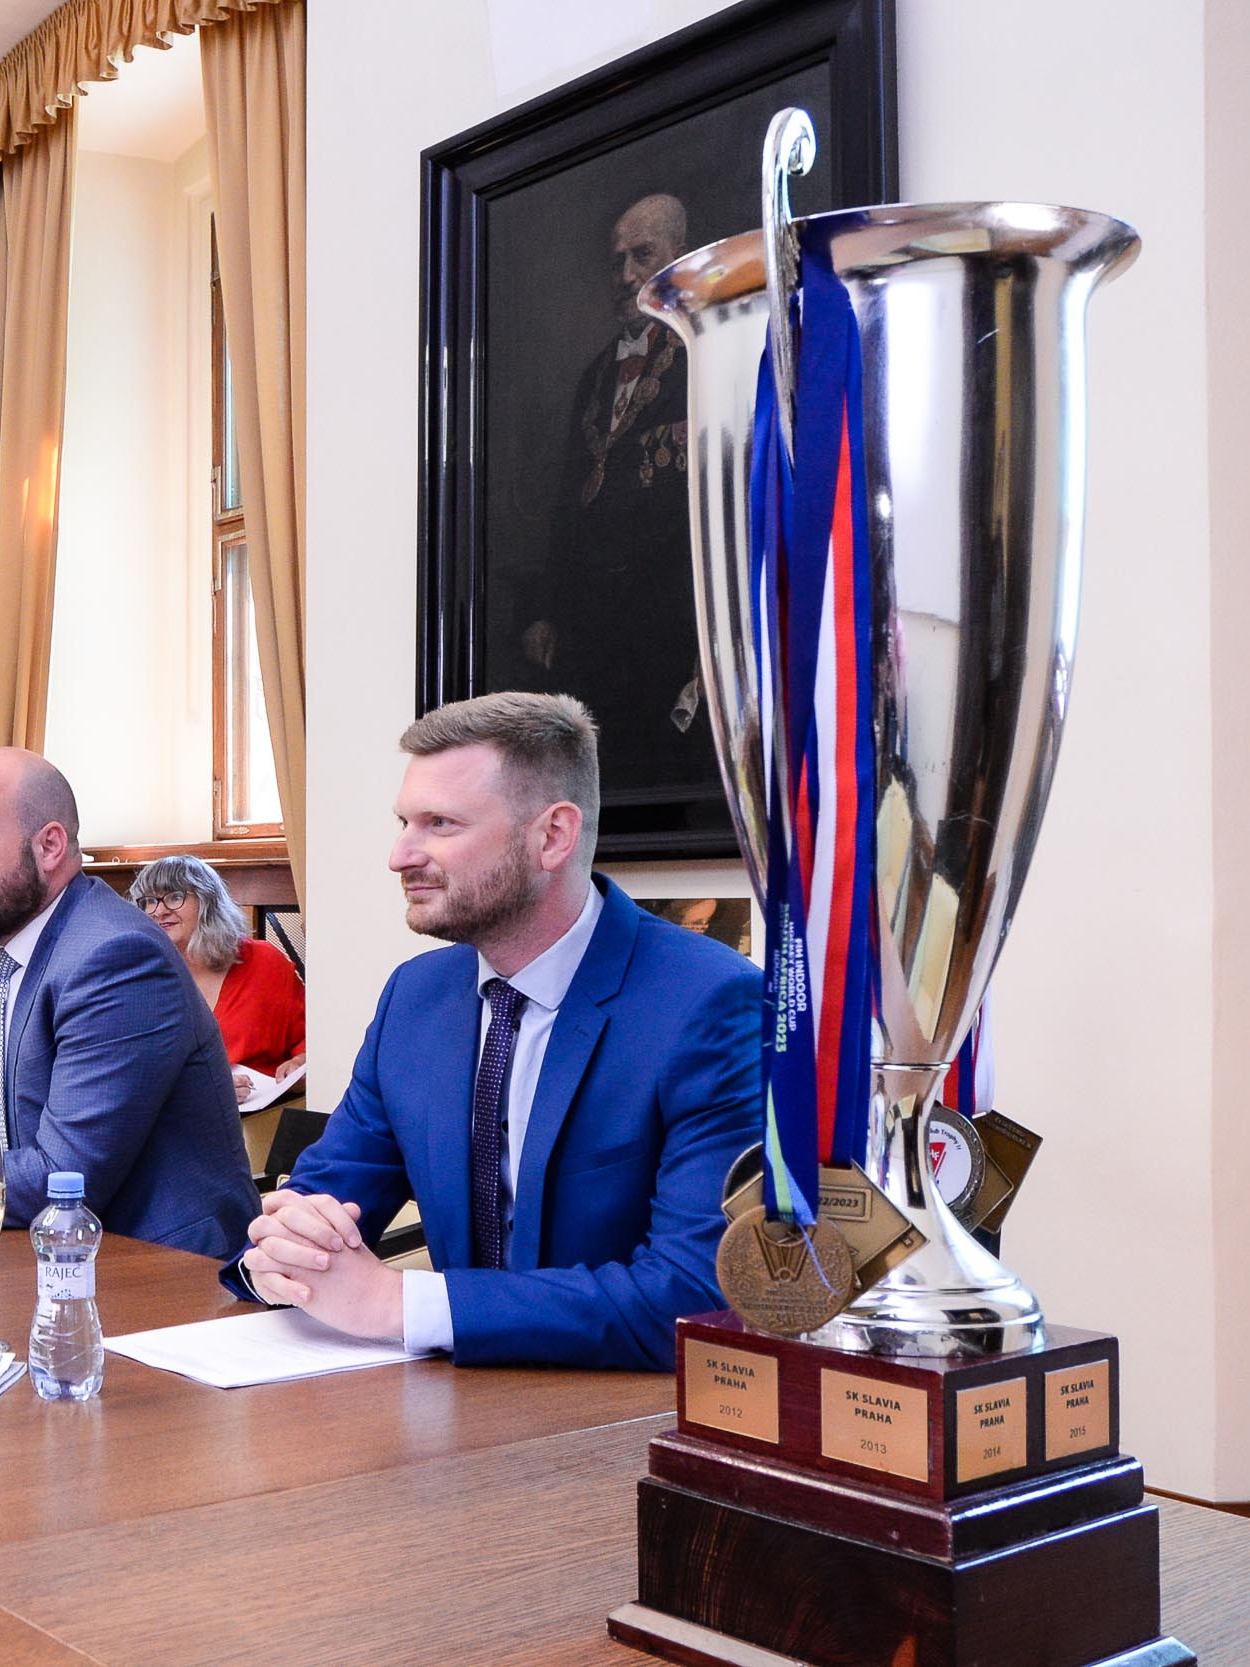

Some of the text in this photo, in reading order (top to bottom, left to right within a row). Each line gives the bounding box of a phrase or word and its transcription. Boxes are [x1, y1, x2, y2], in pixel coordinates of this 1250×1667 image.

[795, 938, 807, 1012] FIH INDOOR
[778, 957, 788, 1012] AFRICA
[788, 967, 796, 1008] WORLD
[788, 1009, 797, 1032] CUP
[775, 1013, 787, 1053] 2023
[706, 1359, 756, 1378] SK SLAVIA
[713, 1375, 748, 1391] PRAHA
[1060, 1379, 1095, 1396] SK SLAVIA
[845, 1390, 902, 1411] SK SLAVIA
[973, 1397, 1011, 1415] SK SLAVIA
[1066, 1396, 1090, 1409] PRAHA
[718, 1404, 743, 1419] 2012
[854, 1407, 892, 1425] PRAHA
[979, 1415, 1005, 1429] PRAHA
[1069, 1425, 1087, 1439] 2015
[860, 1439, 887, 1455] 2013
[982, 1446, 1001, 1460] 2014
